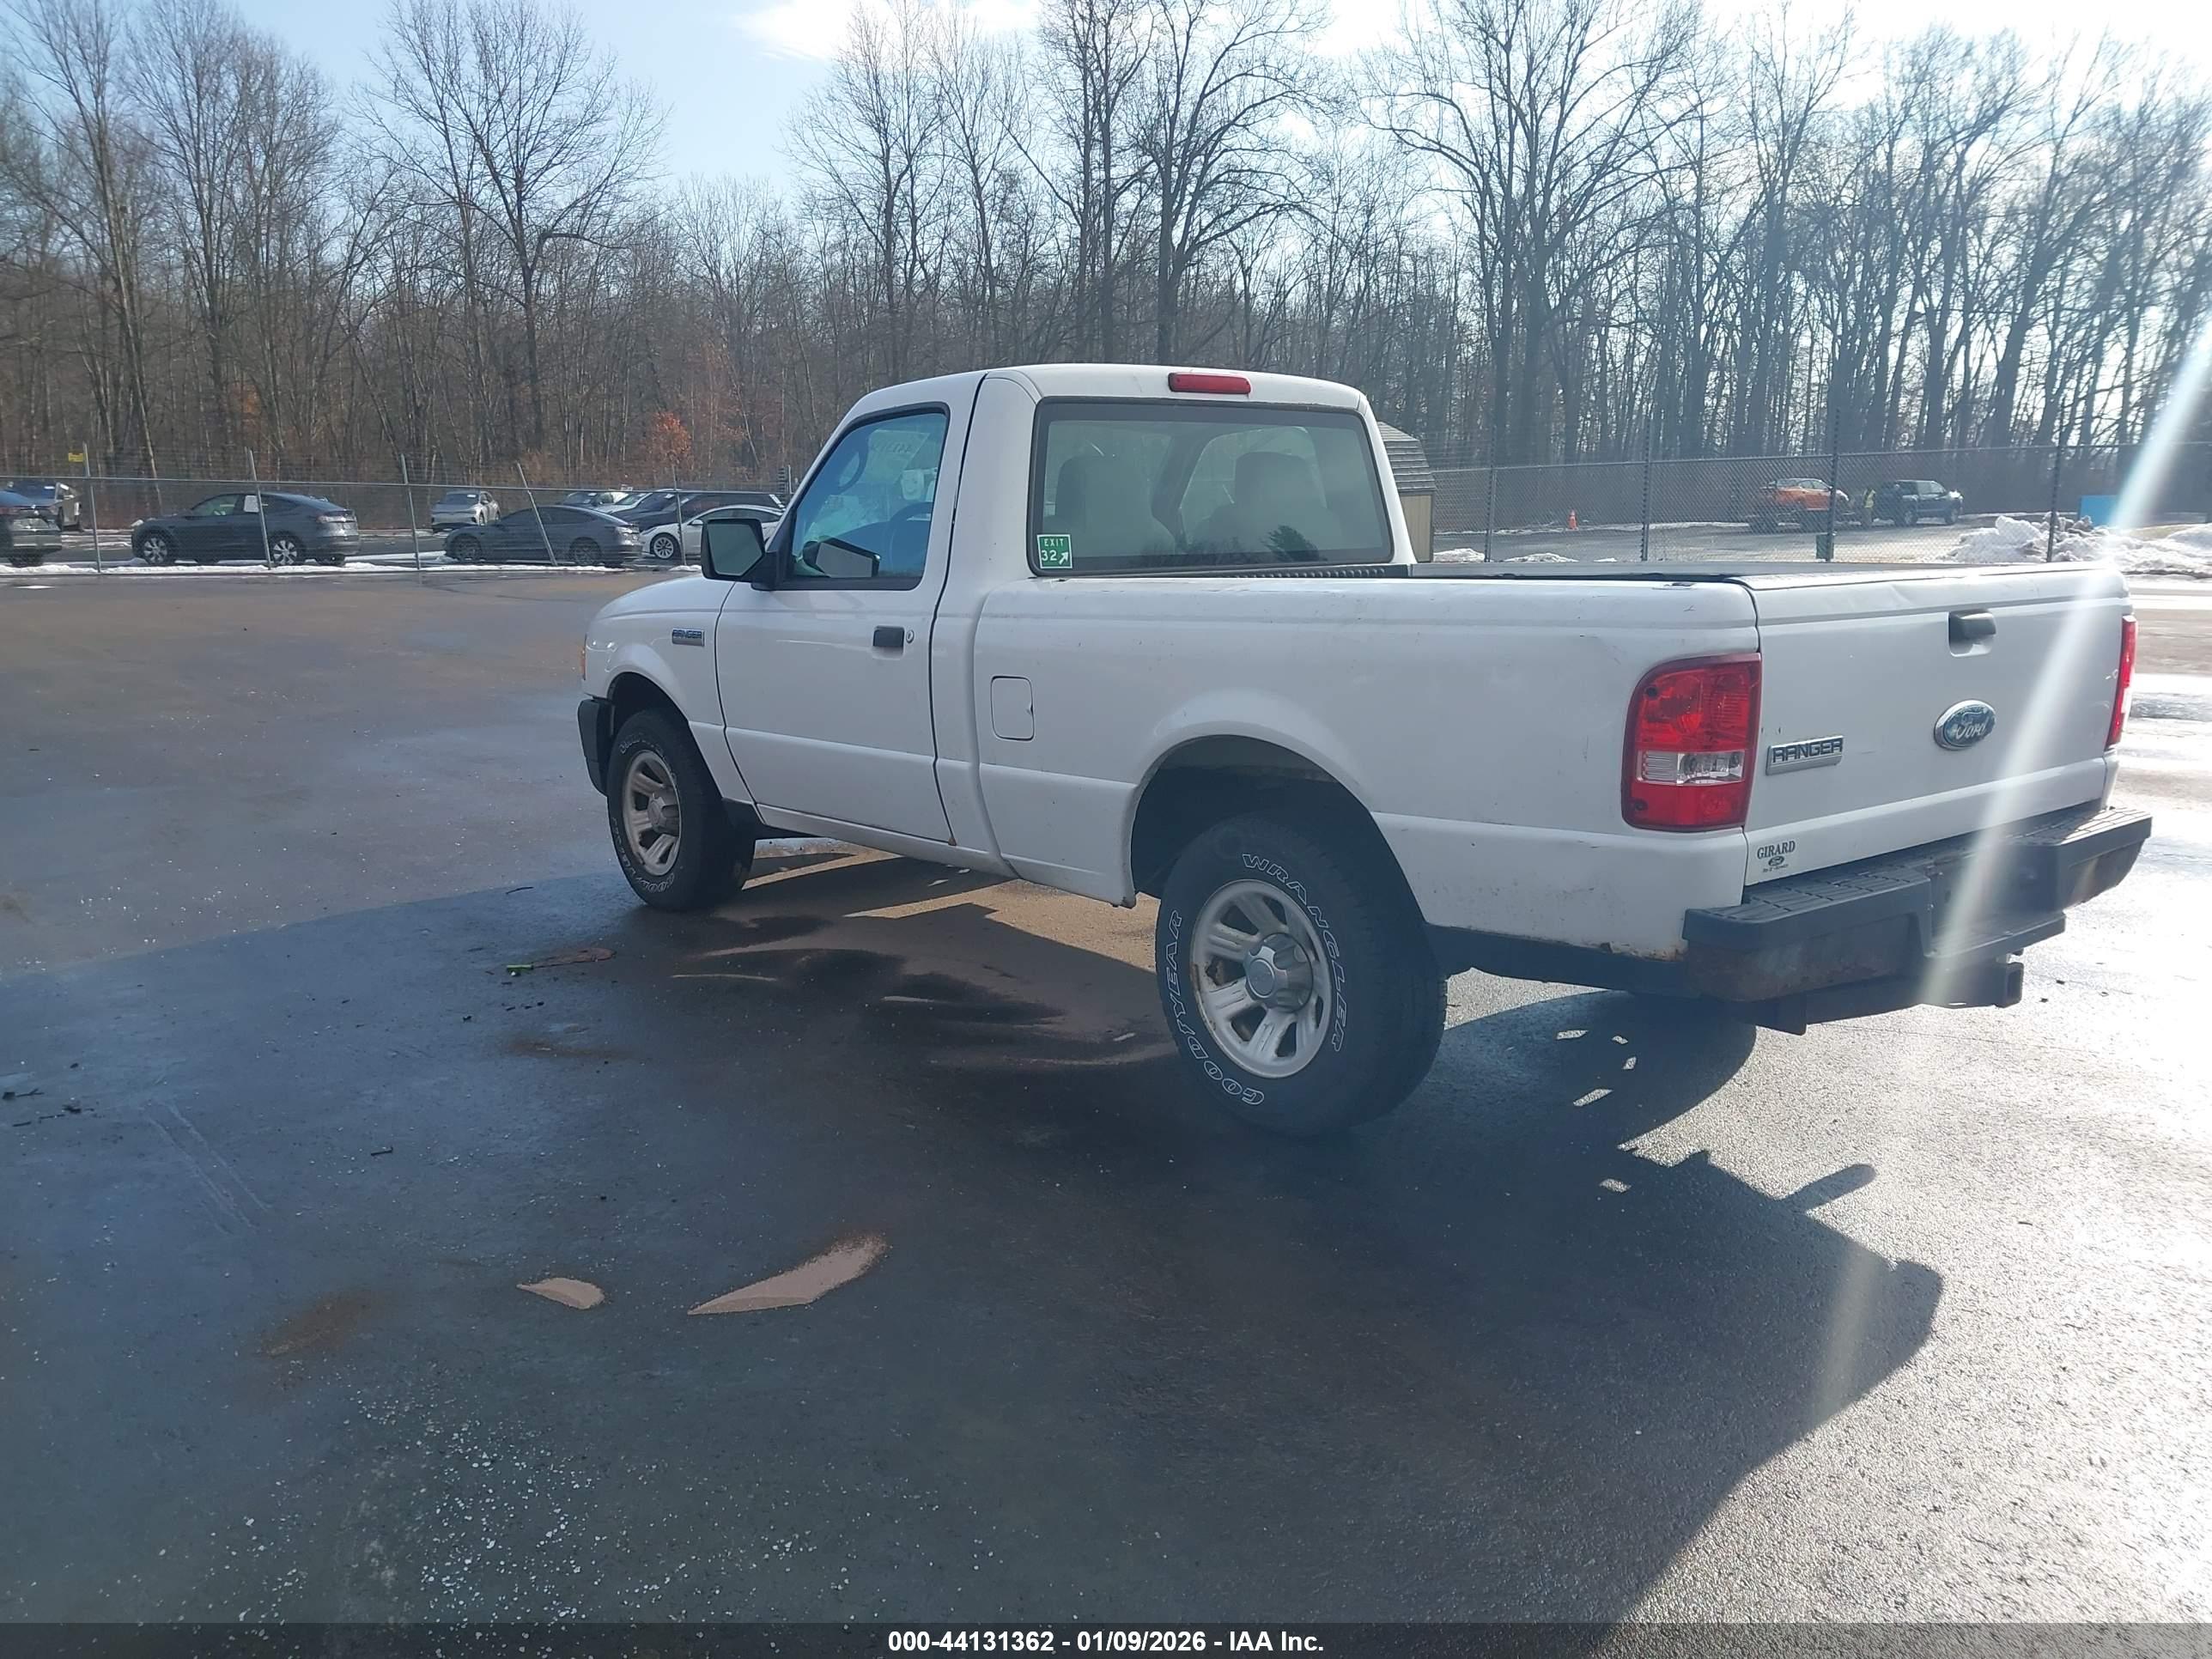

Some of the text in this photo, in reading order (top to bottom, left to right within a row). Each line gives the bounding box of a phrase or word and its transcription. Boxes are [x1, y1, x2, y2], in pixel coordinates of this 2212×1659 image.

[1043, 538, 1064, 547] EXIT
[1041, 550, 1058, 562] 32
[1772, 738, 1844, 763] RANGER
[1757, 840, 1796, 860] GIRARD
[1242, 854, 1347, 1052] WRANGLER
[1165, 910, 1265, 1105] GOODYEAR
